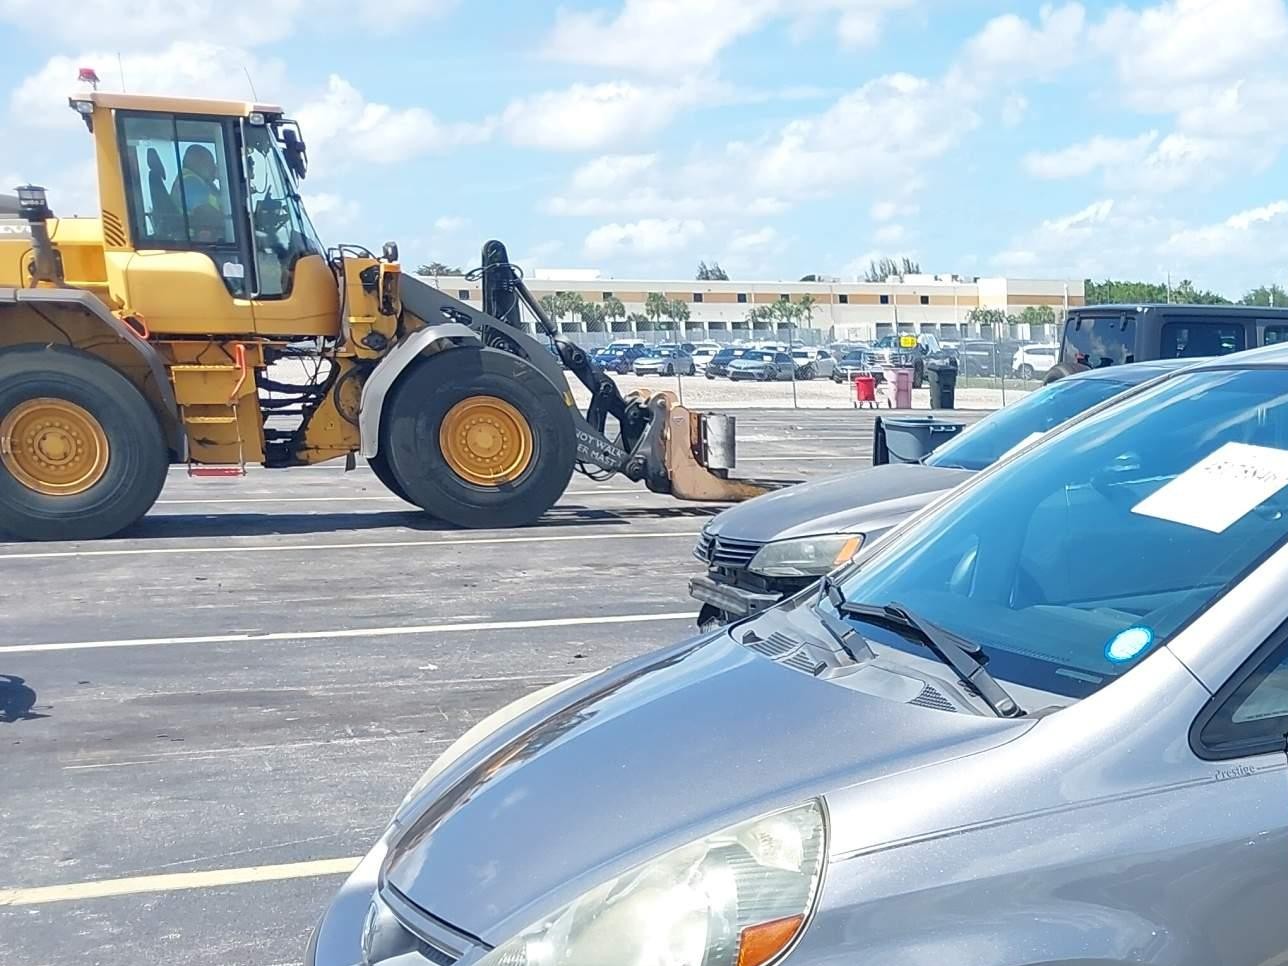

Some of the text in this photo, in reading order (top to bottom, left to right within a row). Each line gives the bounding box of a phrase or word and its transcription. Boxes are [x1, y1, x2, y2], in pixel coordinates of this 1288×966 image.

[597, 440, 626, 458] WALK
[591, 451, 617, 466] MAST
[1215, 765, 1256, 780] Prestige
